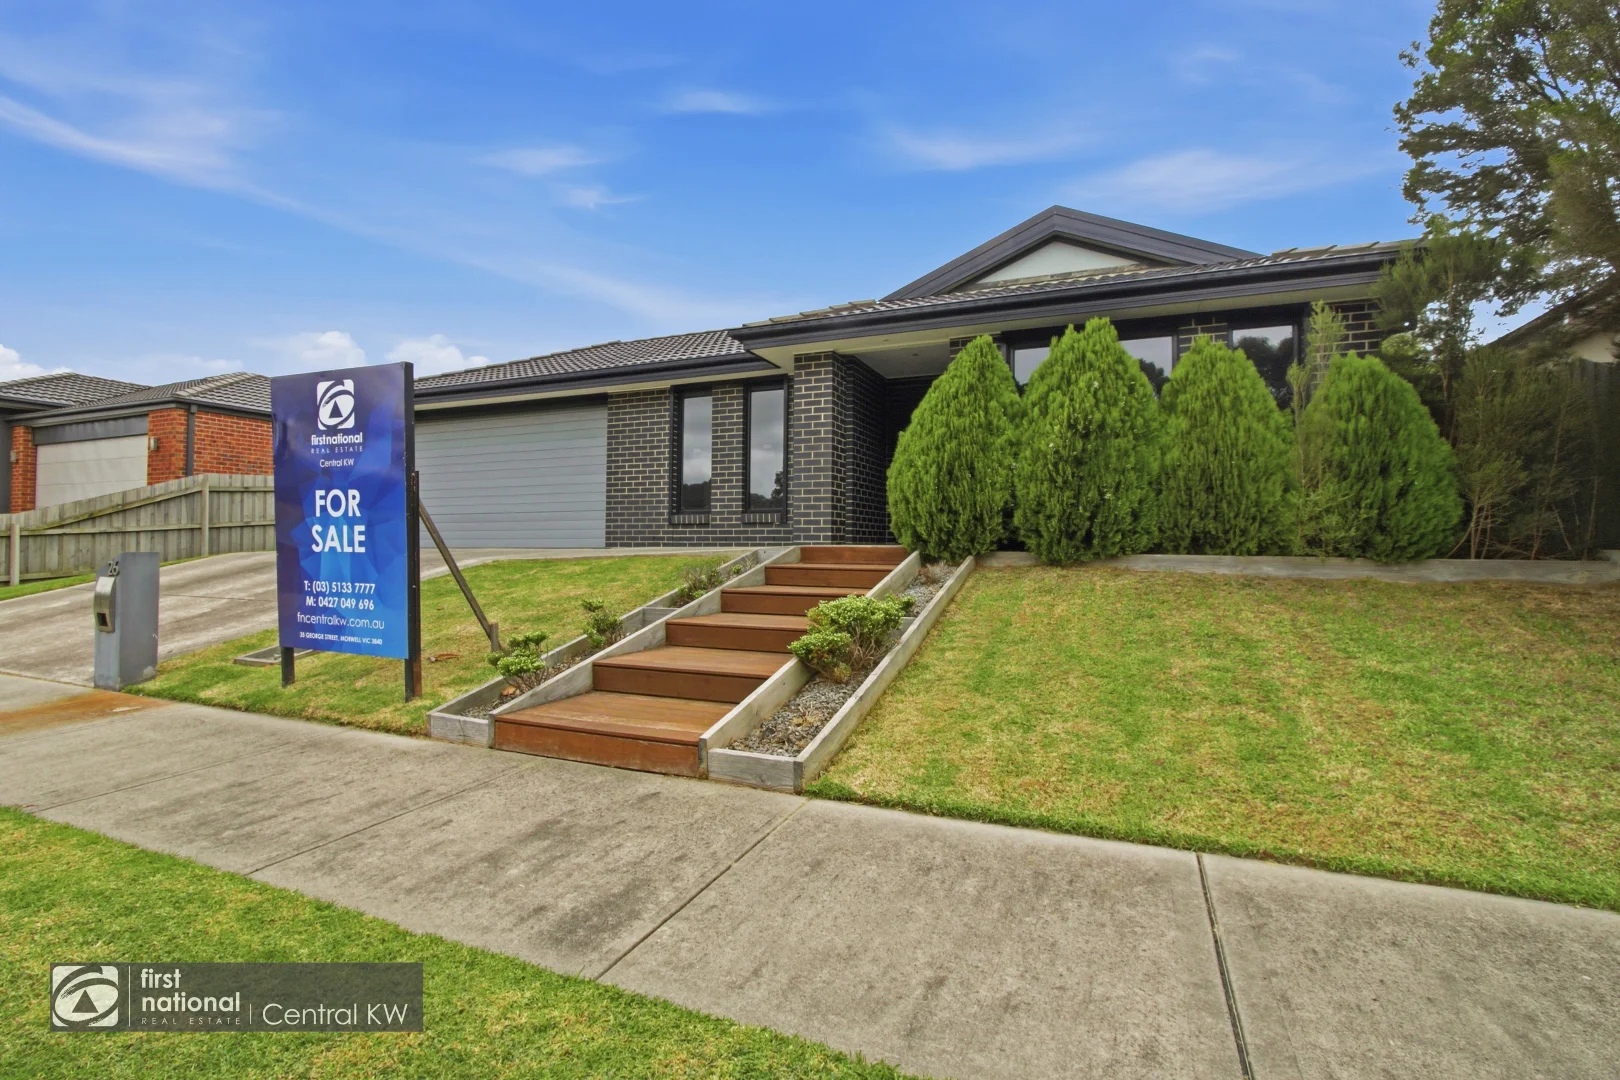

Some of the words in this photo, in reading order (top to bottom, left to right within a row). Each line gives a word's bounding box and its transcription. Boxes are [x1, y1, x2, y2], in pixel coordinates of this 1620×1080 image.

[320, 459, 342, 468] Central
[343, 458, 354, 466] KW
[315, 489, 361, 518] FOR
[311, 524, 366, 553] SALE
[107, 561, 120, 576] 26
[304, 580, 311, 591] T:
[312, 580, 330, 595] (03)
[331, 581, 352, 593] 5133
[354, 583, 376, 595] 7777
[305, 596, 316, 607] M:
[318, 596, 338, 608] 0427
[340, 597, 356, 609] 049
[358, 599, 375, 611] 696
[297, 611, 385, 629] fncentralkw.com.au
